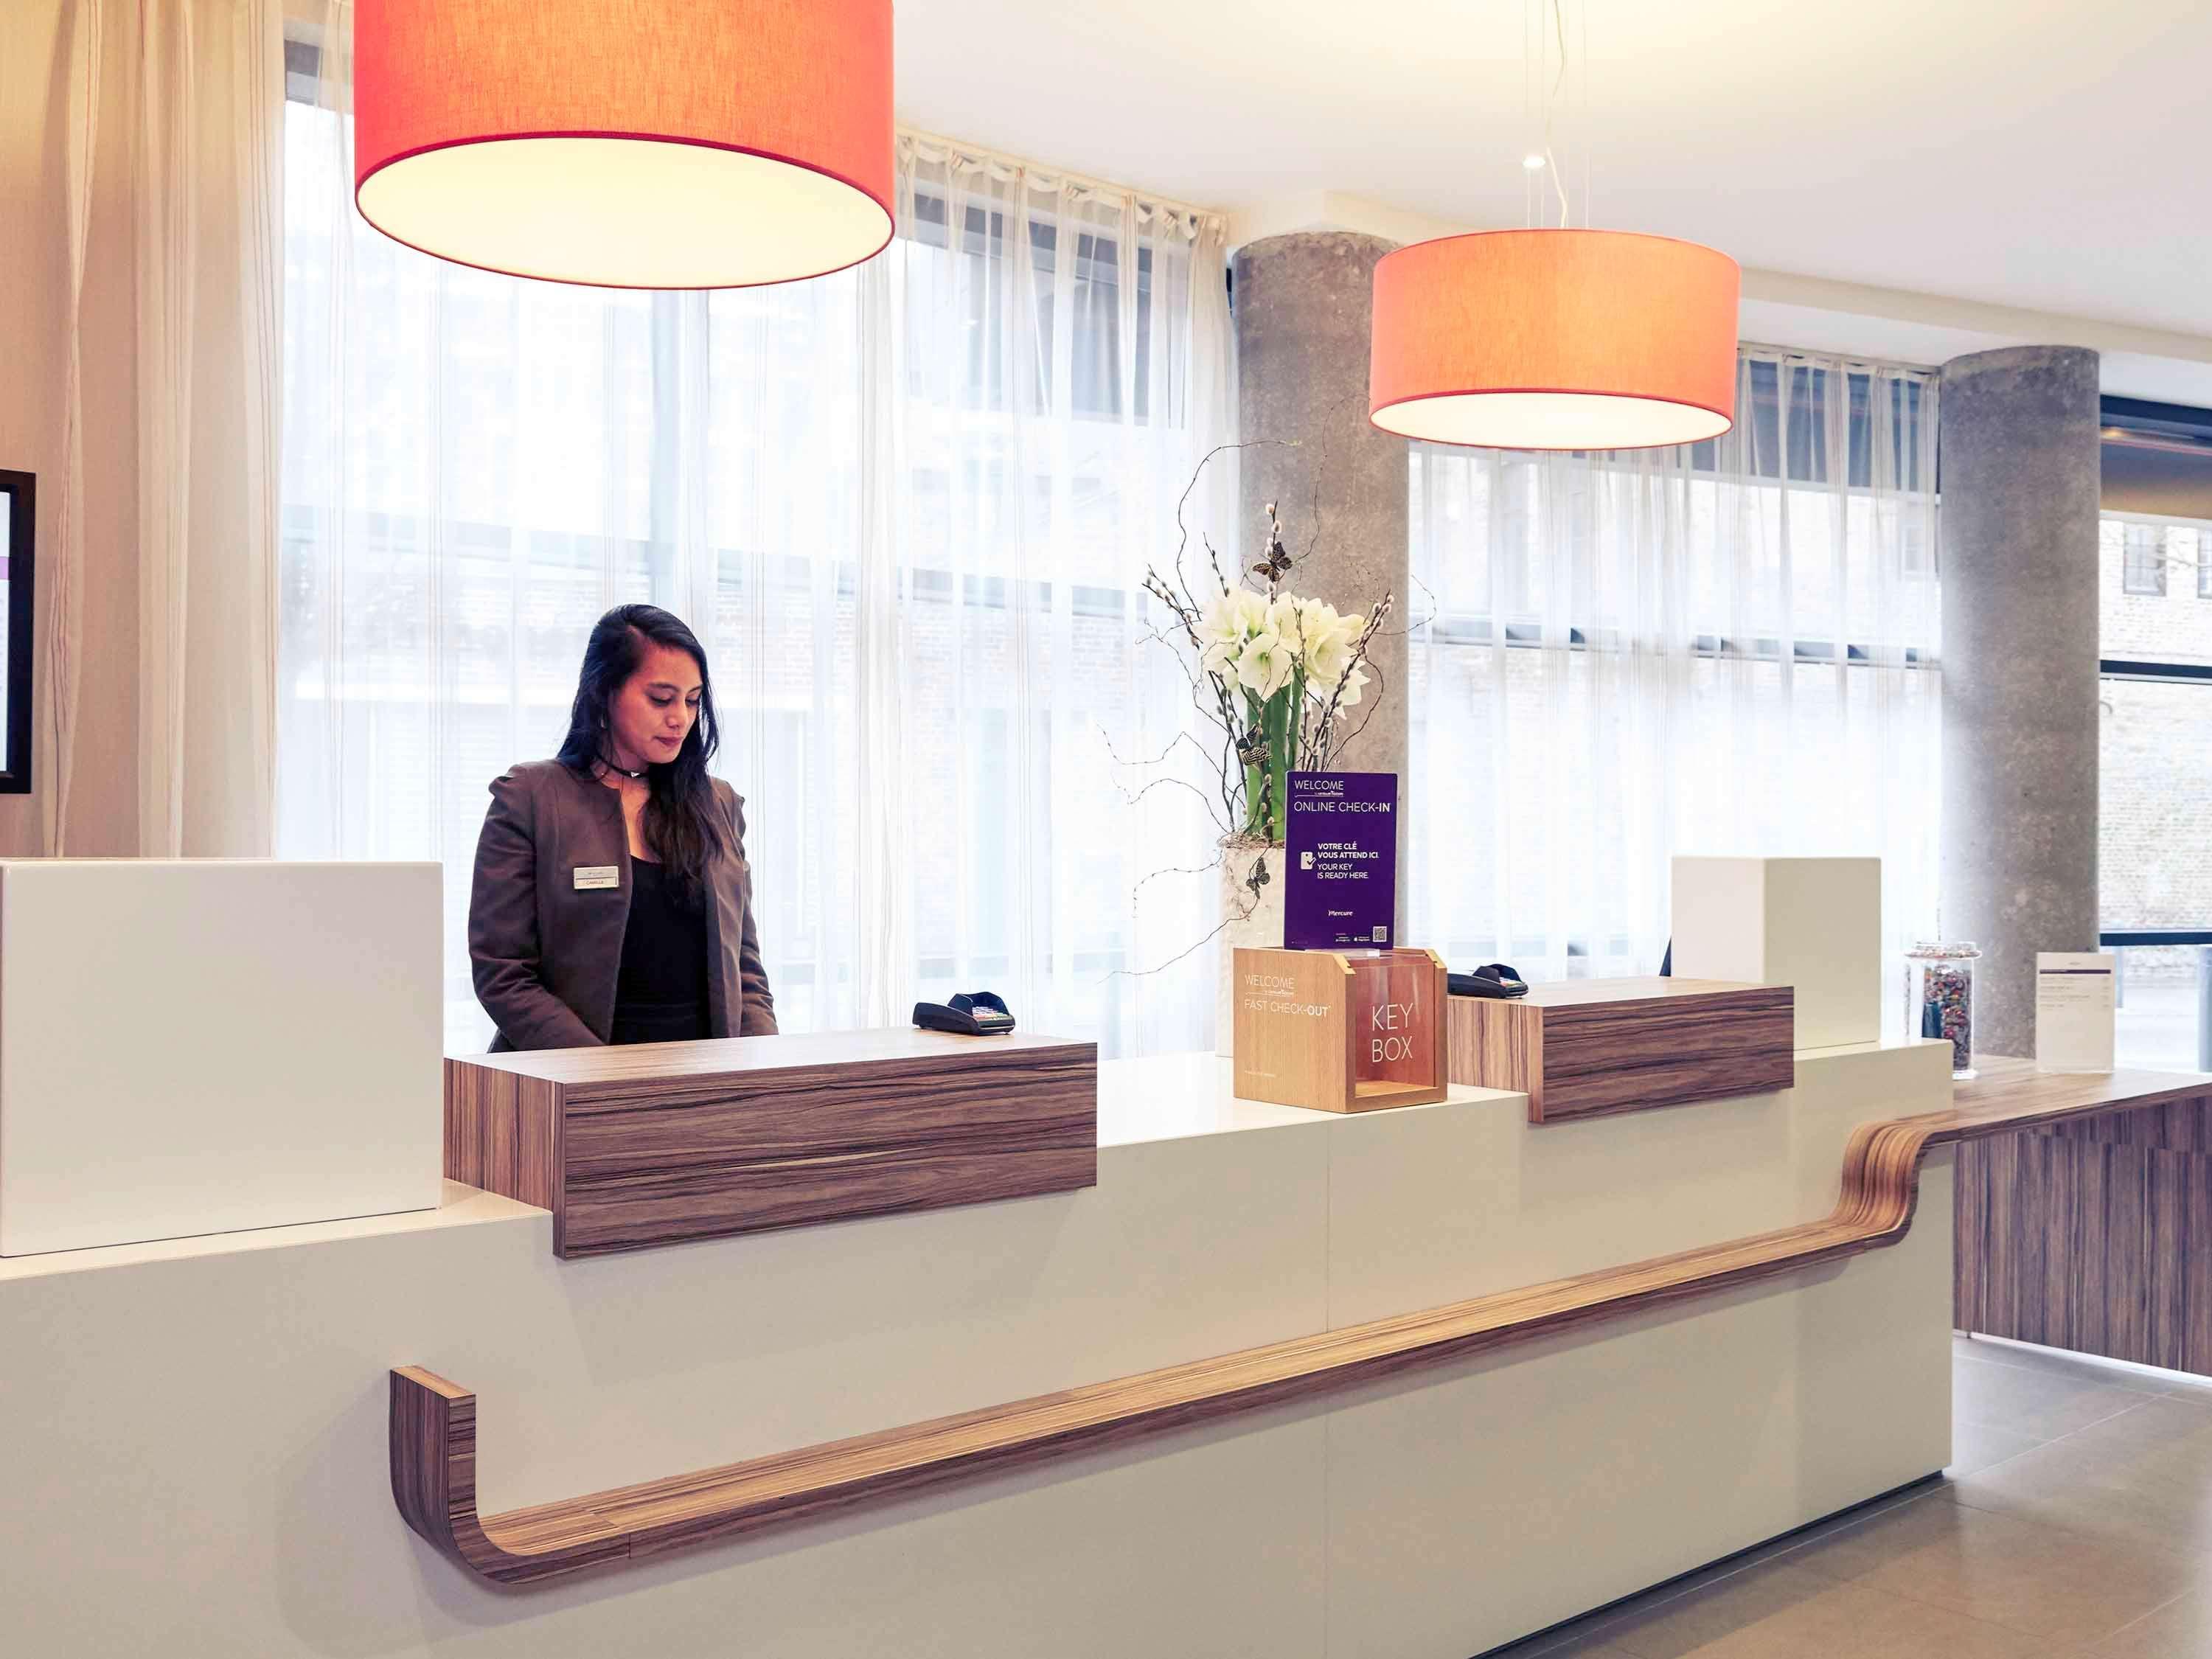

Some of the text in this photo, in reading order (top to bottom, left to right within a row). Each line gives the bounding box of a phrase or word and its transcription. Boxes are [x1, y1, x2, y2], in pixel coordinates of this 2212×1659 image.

[1295, 780, 1344, 790] WELCOME
[1294, 801, 1391, 813] ONLINE CHECK-IN
[1343, 841, 1357, 850] CLÉ
[1245, 974, 1295, 990] WELCOME
[1244, 999, 1268, 1010] FAST
[1371, 1003, 1413, 1031] KEY
[1372, 1036, 1413, 1062] BOX
